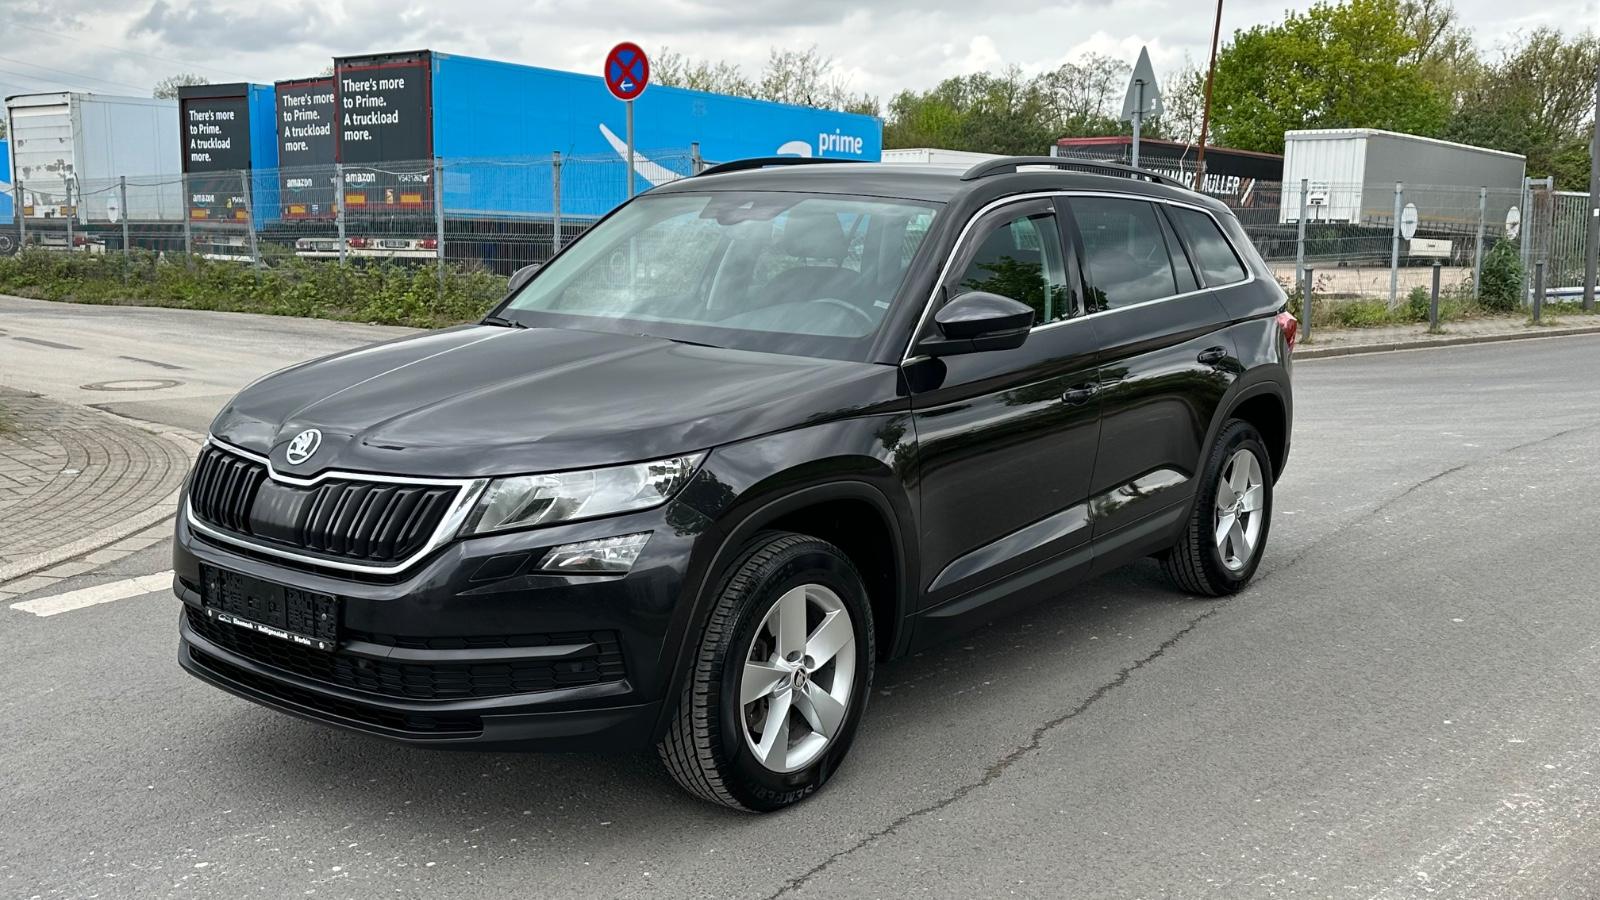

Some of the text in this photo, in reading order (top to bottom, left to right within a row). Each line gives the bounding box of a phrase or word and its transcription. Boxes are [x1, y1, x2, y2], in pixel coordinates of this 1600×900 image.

[343, 78, 405, 92] There's more
[282, 93, 335, 107] There's more
[343, 94, 387, 109] to Prime.
[189, 110, 235, 121] There's more
[283, 108, 320, 122] to Prime.
[344, 110, 399, 126] A truckload
[190, 123, 222, 135] to Prime.
[284, 122, 331, 138] A truckload
[344, 130, 372, 141] more.
[191, 137, 231, 149] A truckload
[285, 141, 309, 151] more.
[819, 128, 863, 156] prime
[191, 153, 211, 162] more.
[286, 178, 313, 188] amazon
[345, 172, 376, 183] amazon
